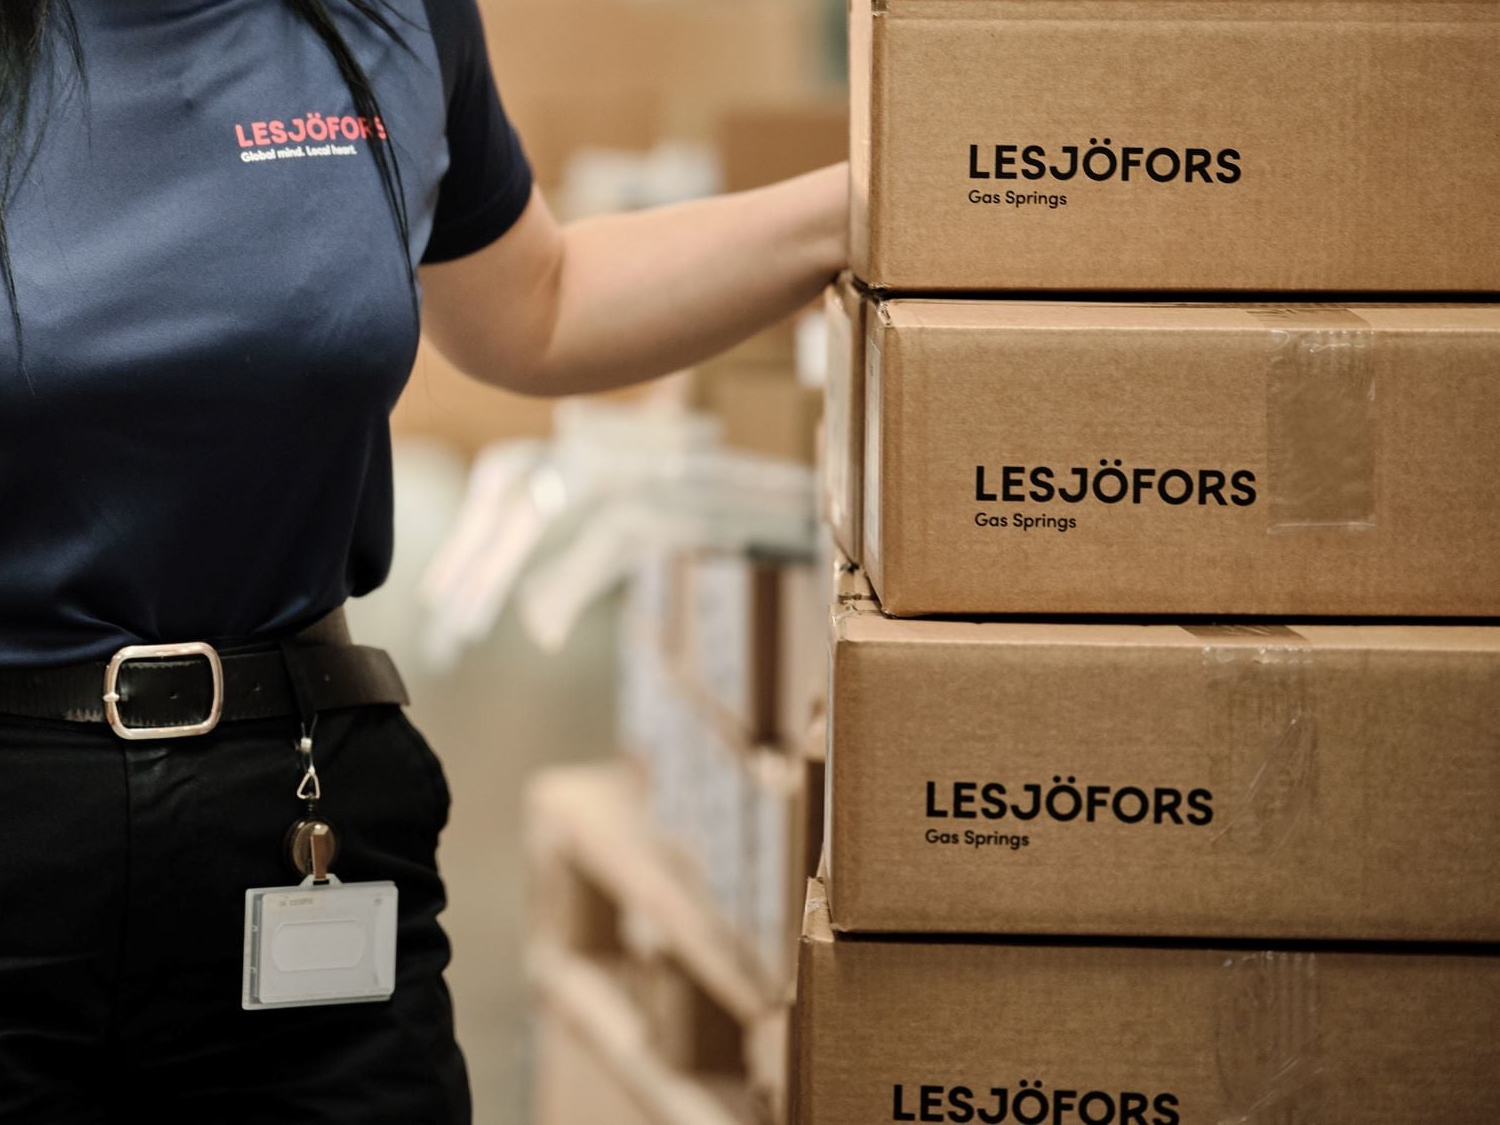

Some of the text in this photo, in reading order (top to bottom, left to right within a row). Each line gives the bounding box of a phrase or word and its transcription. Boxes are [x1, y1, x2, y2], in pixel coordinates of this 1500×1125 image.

[240, 149, 277, 163] Global
[276, 146, 306, 159] mind.
[306, 144, 332, 156] Local
[969, 137, 1242, 184] LESJÖFORS
[968, 189, 1067, 209] Gas Springs
[975, 458, 1257, 507] LESJÖFORS
[974, 512, 1077, 533] Gas Springs
[926, 775, 1214, 826] LESJÖFORS
[925, 828, 1030, 851] Gas Springs
[893, 1079, 1180, 1125] LESJÖFORS
